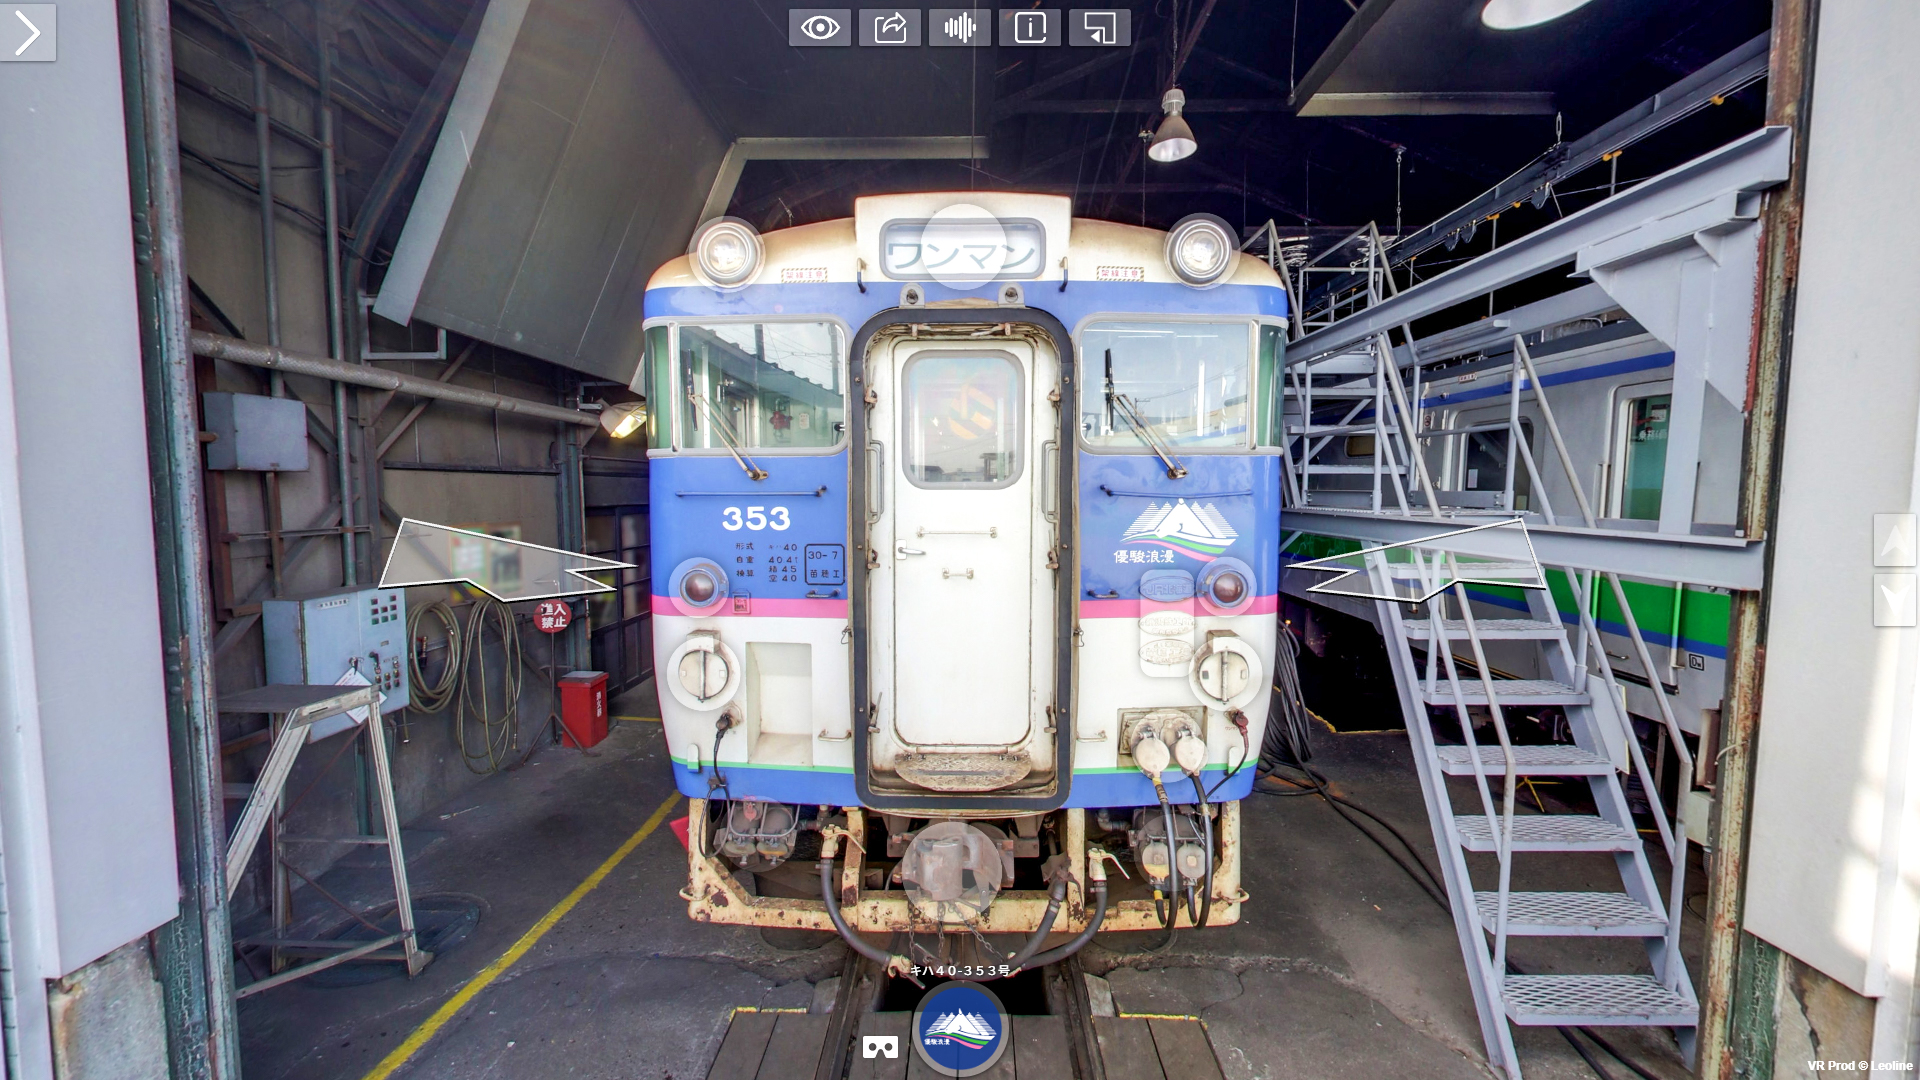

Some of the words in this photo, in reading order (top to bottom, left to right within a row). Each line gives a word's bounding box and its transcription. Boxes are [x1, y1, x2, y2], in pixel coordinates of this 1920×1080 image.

[888, 243, 1036, 270] ワンマン
[722, 506, 791, 531] 353
[735, 542, 754, 550] 形式
[1113, 549, 1175, 564] 優駿浪漫
[540, 603, 567, 616] 進入
[541, 616, 568, 629] 禁止
